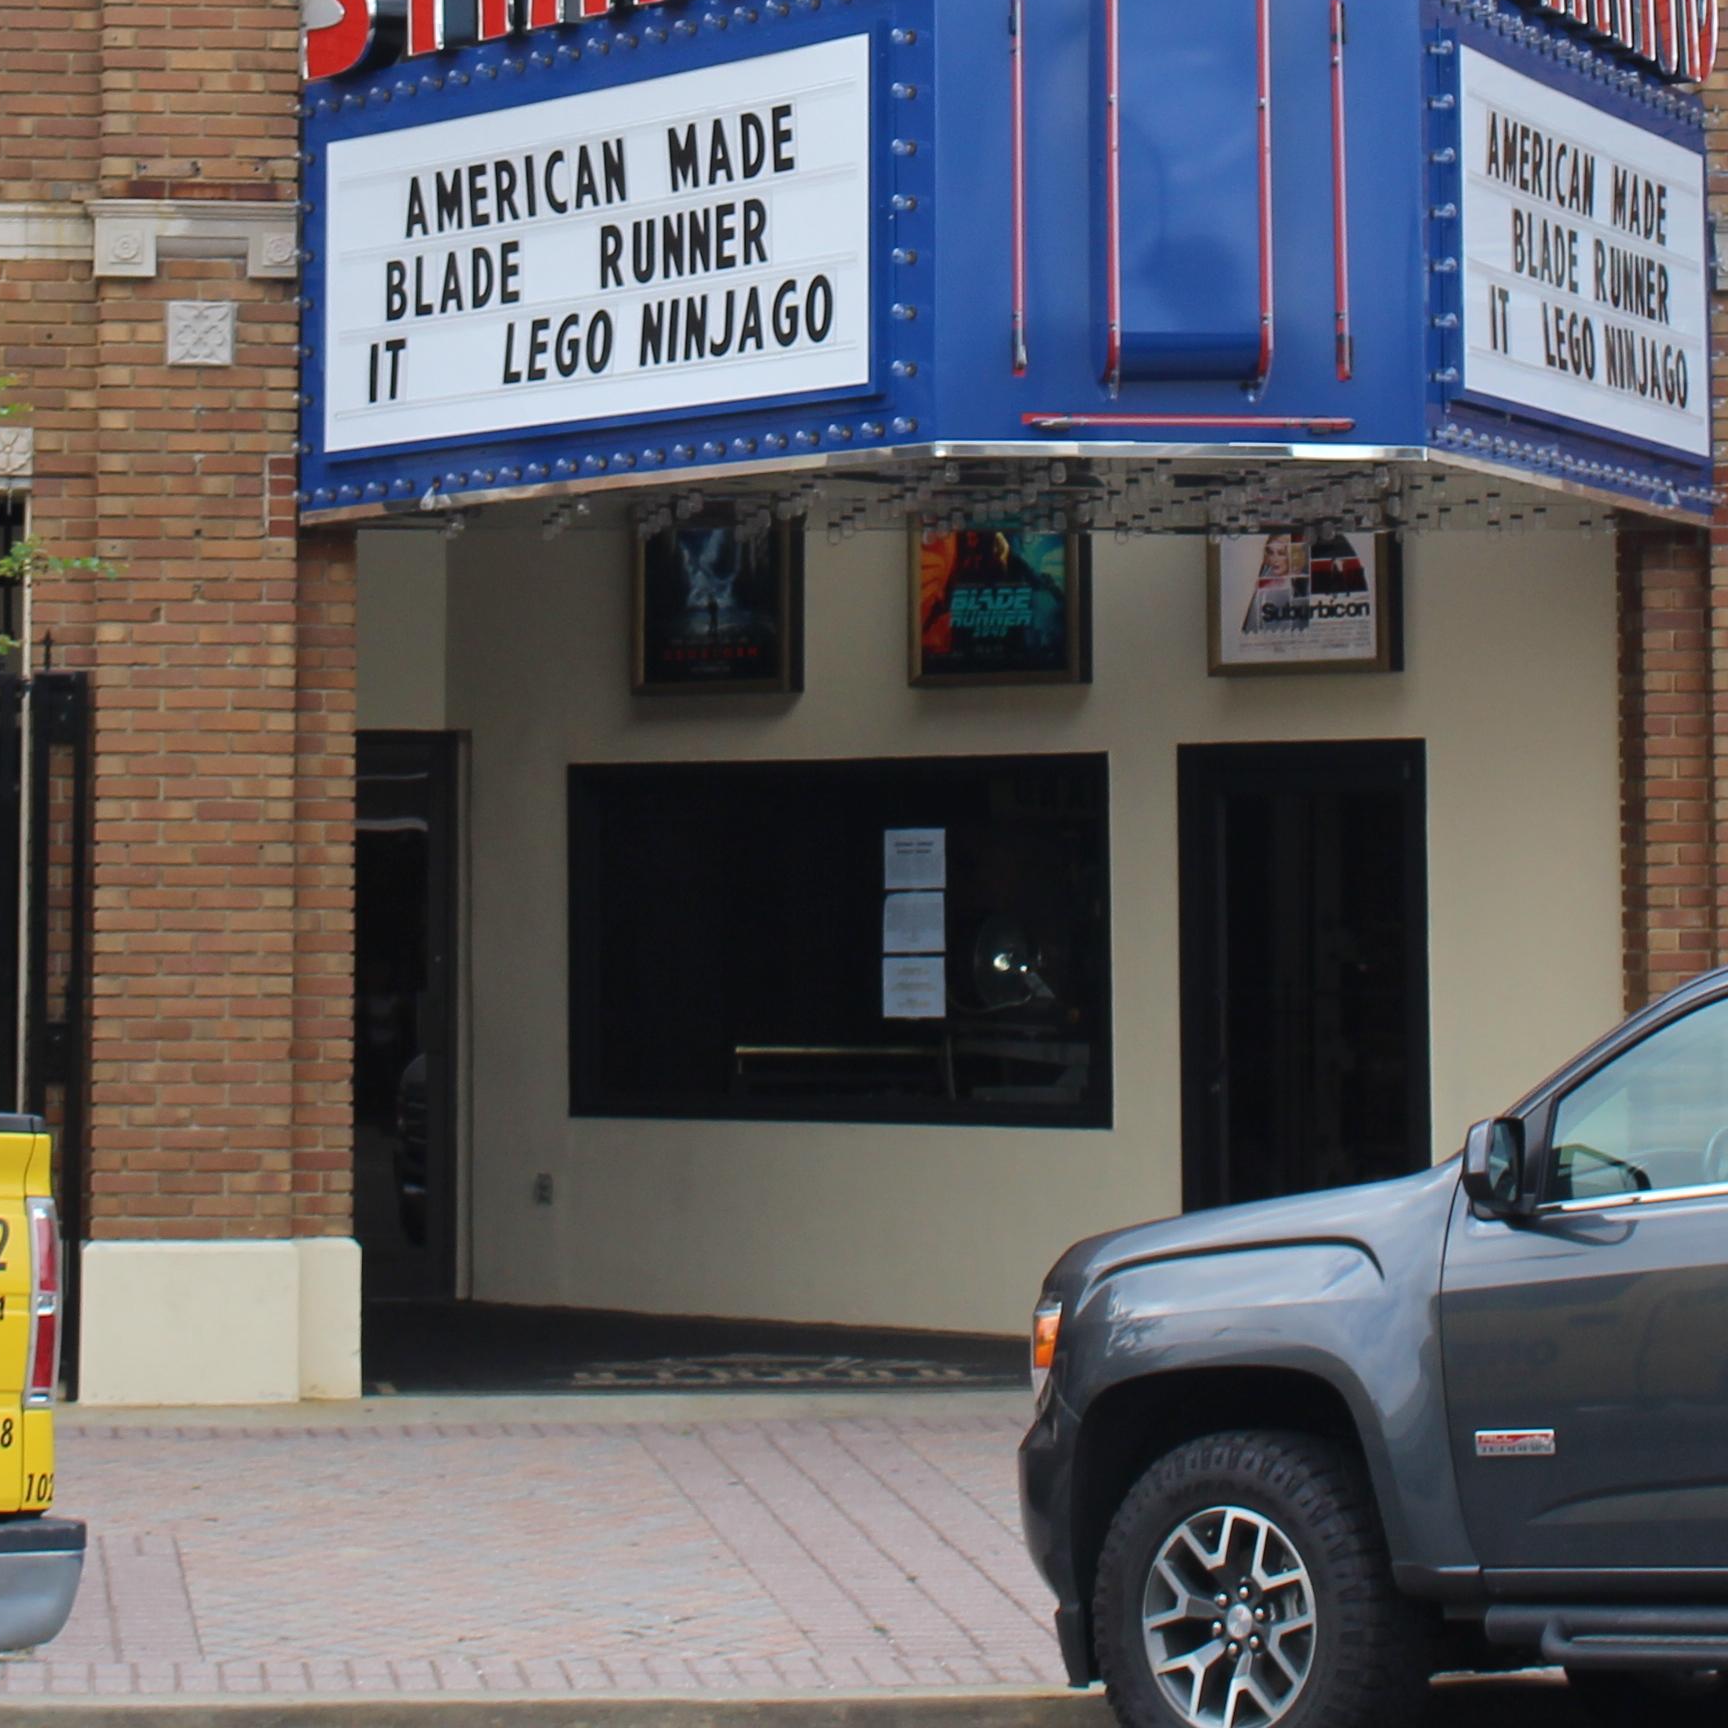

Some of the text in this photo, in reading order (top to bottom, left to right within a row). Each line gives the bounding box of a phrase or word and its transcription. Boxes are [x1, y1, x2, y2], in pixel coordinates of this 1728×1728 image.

[405, 104, 795, 239] AMERICAN MADE
[1488, 112, 1668, 247] AMERICAN MADE
[385, 198, 769, 322] BLADE RUNNER
[1512, 208, 1670, 324] BLADE RUNNER
[369, 273, 834, 403] IT LEGO NINJAGO
[1490, 284, 1689, 410] IT LEGO NINJAGO
[951, 587, 1033, 609] BLADE
